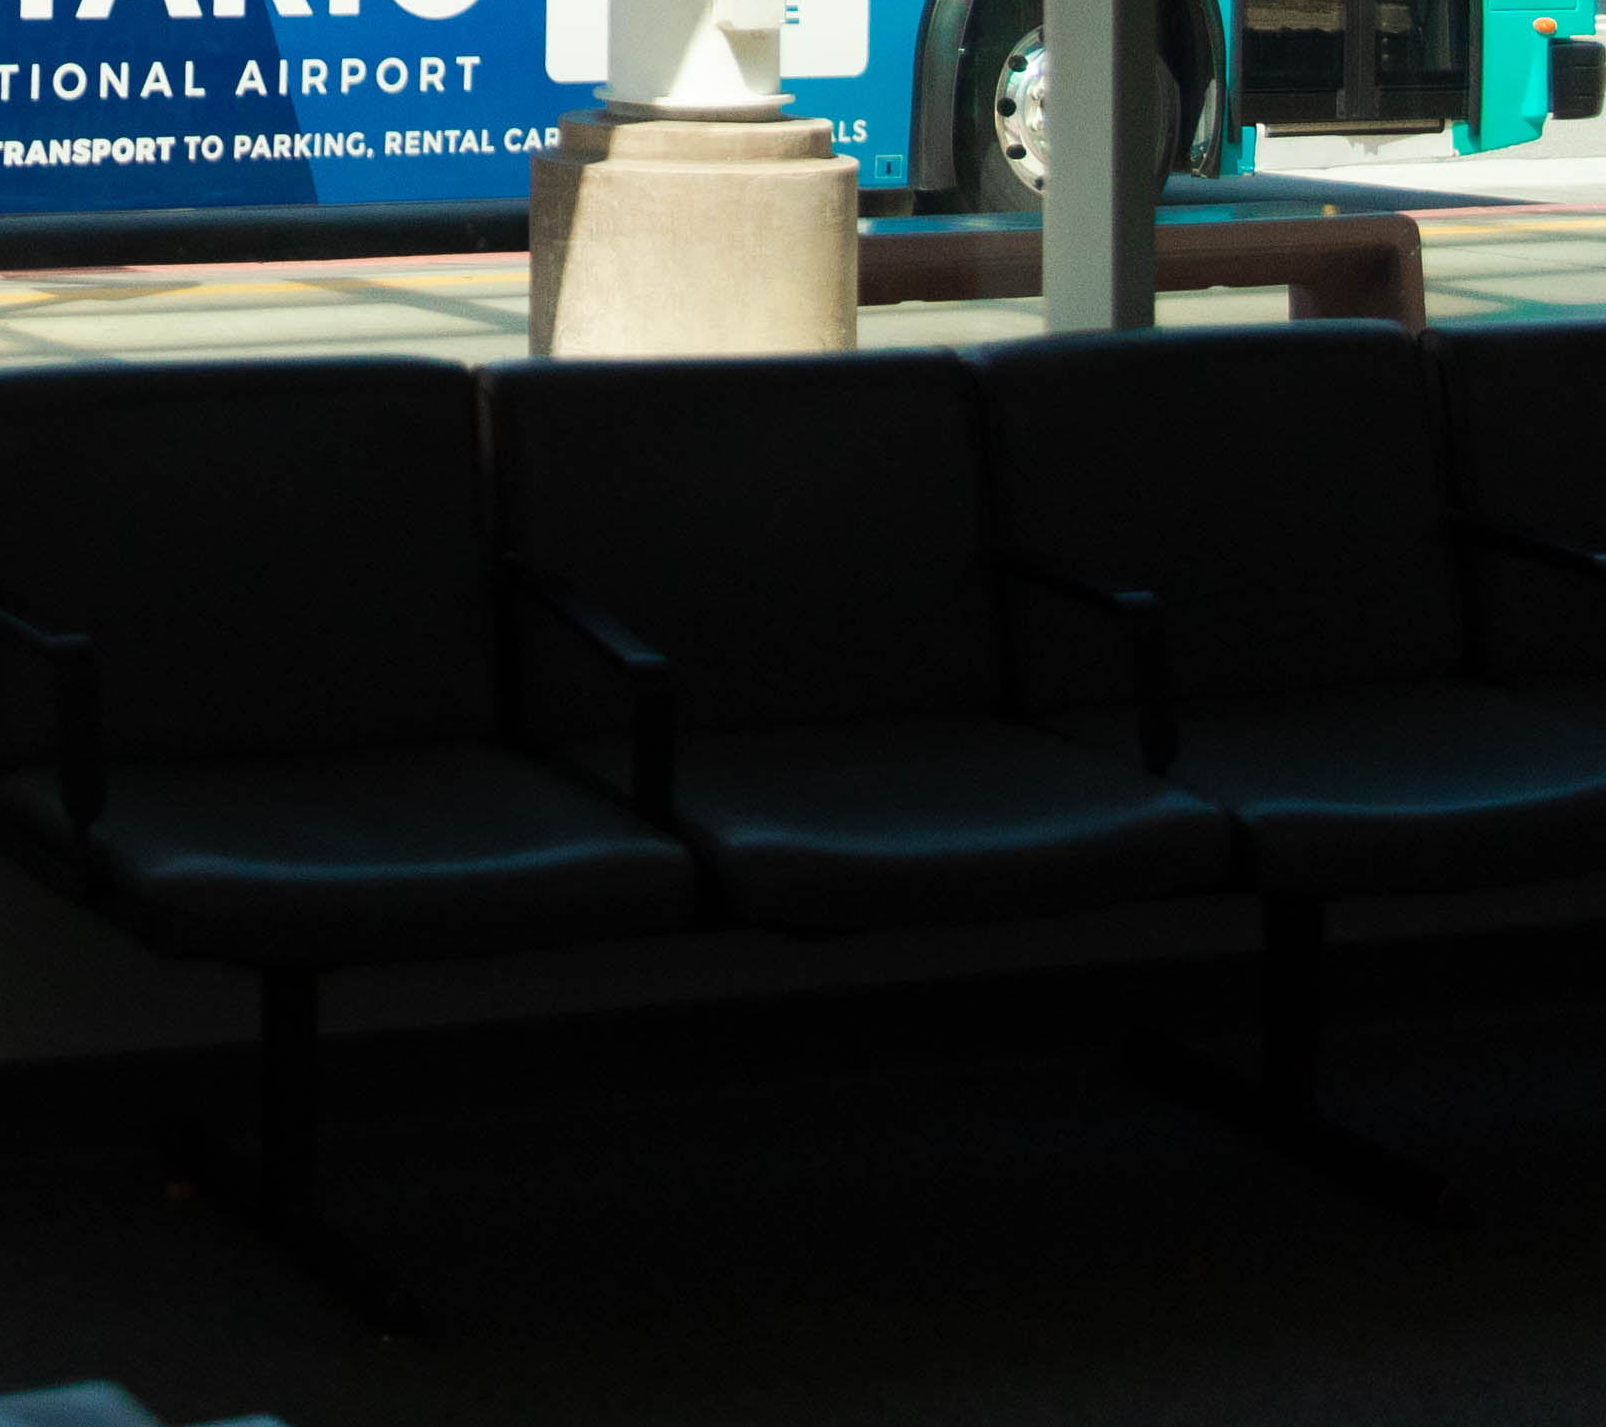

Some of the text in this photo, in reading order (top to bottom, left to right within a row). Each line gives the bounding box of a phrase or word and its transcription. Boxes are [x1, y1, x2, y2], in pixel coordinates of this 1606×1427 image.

[235, 56, 482, 98] AIRPORT
[184, 134, 224, 162] TO
[233, 131, 375, 160] PARKING,
[383, 128, 496, 157] RENTAL
